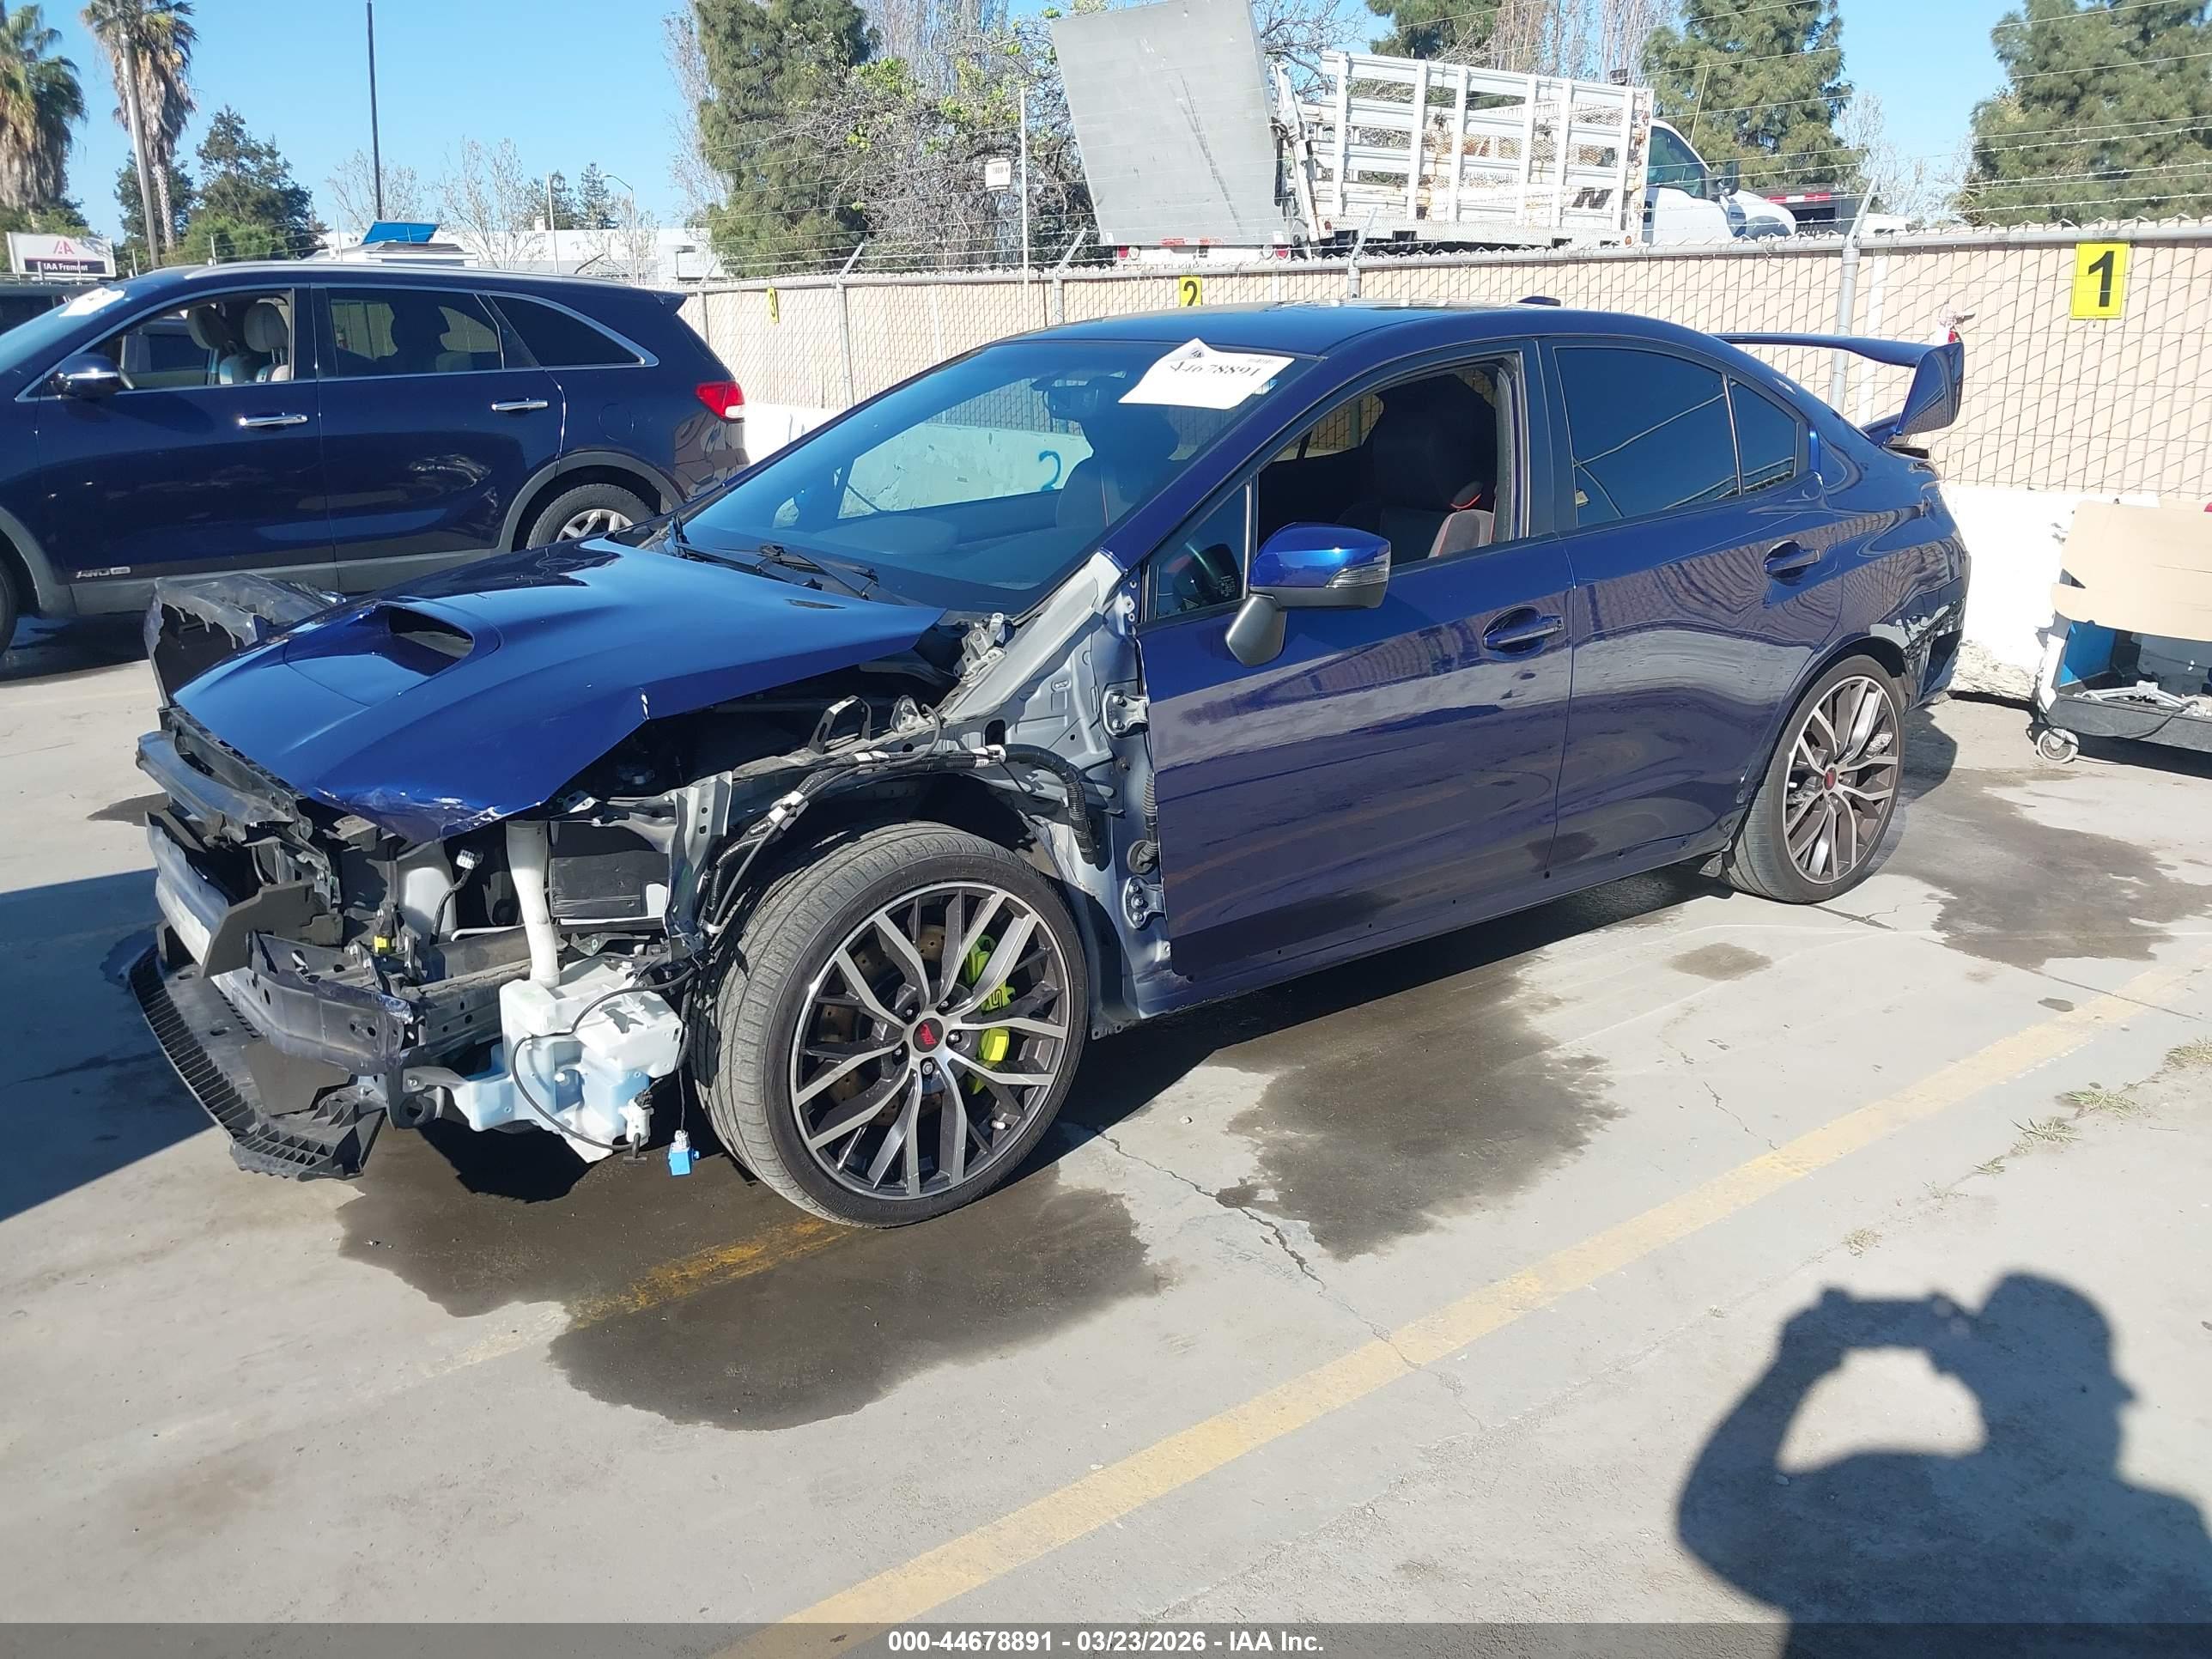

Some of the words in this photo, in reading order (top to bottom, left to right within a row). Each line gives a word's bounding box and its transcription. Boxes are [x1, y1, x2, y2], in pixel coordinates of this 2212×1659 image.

[2087, 251, 2115, 307] 1
[769, 292, 776, 318] 3
[1183, 280, 1198, 307] 2
